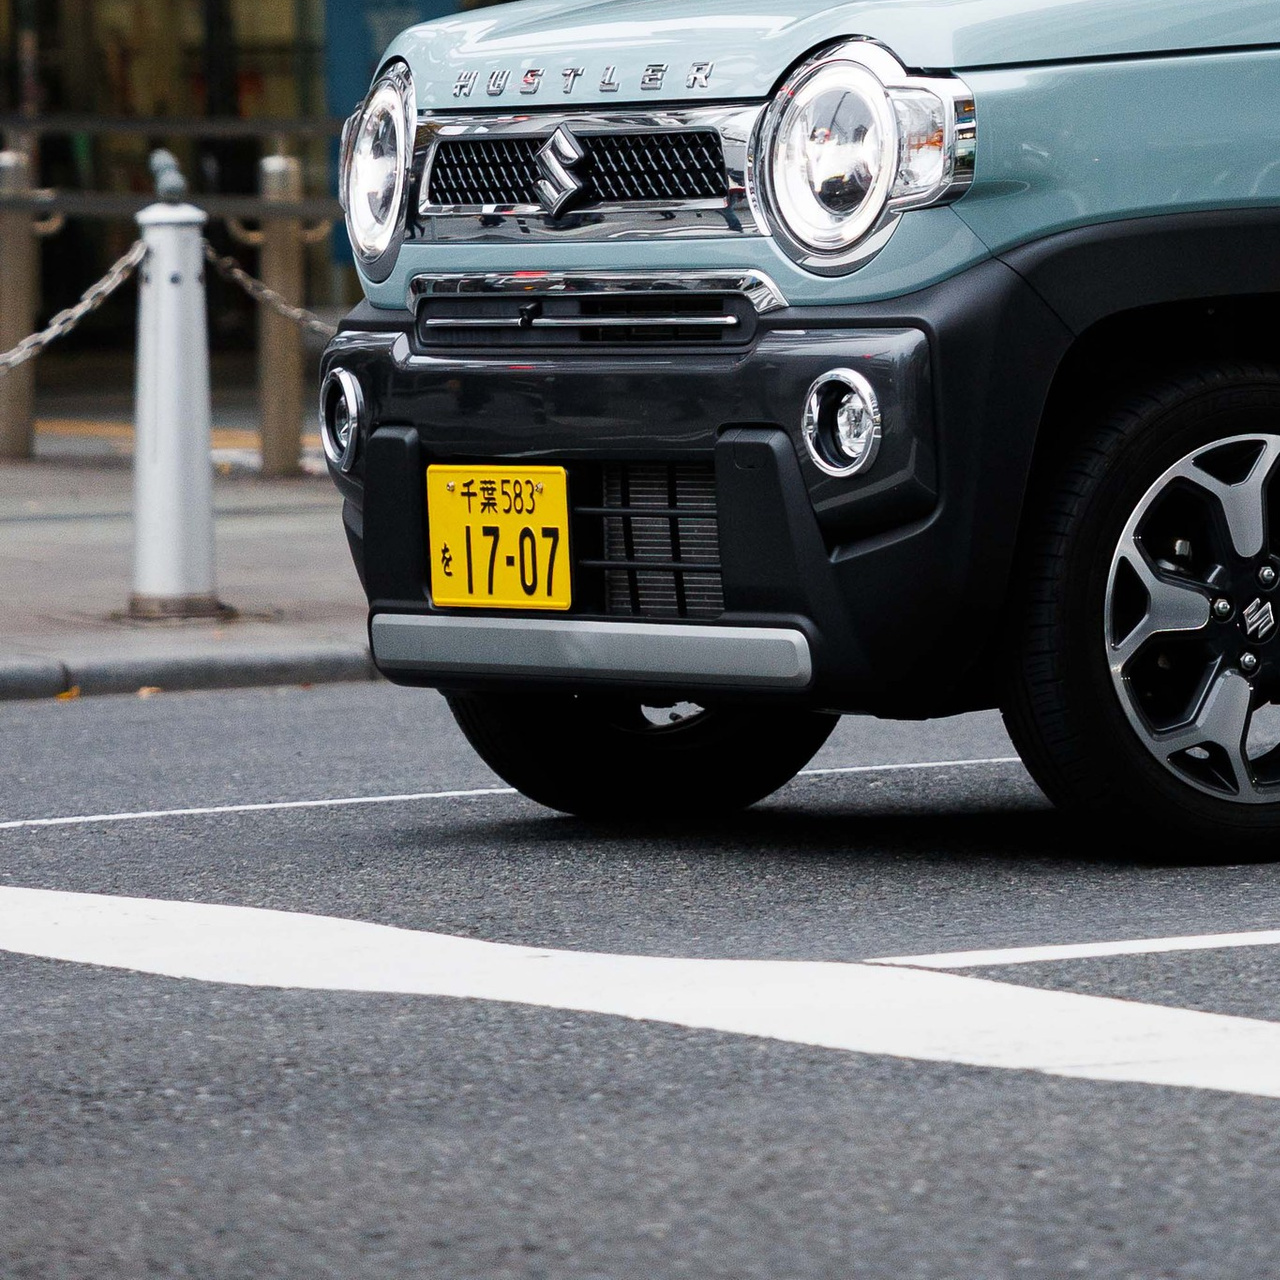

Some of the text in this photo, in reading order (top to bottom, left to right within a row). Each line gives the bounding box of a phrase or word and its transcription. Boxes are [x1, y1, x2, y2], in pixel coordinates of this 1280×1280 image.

[453, 61, 714, 98] HUSTLER
[460, 478, 536, 515] 千葉583
[441, 525, 560, 597] を 17-07
